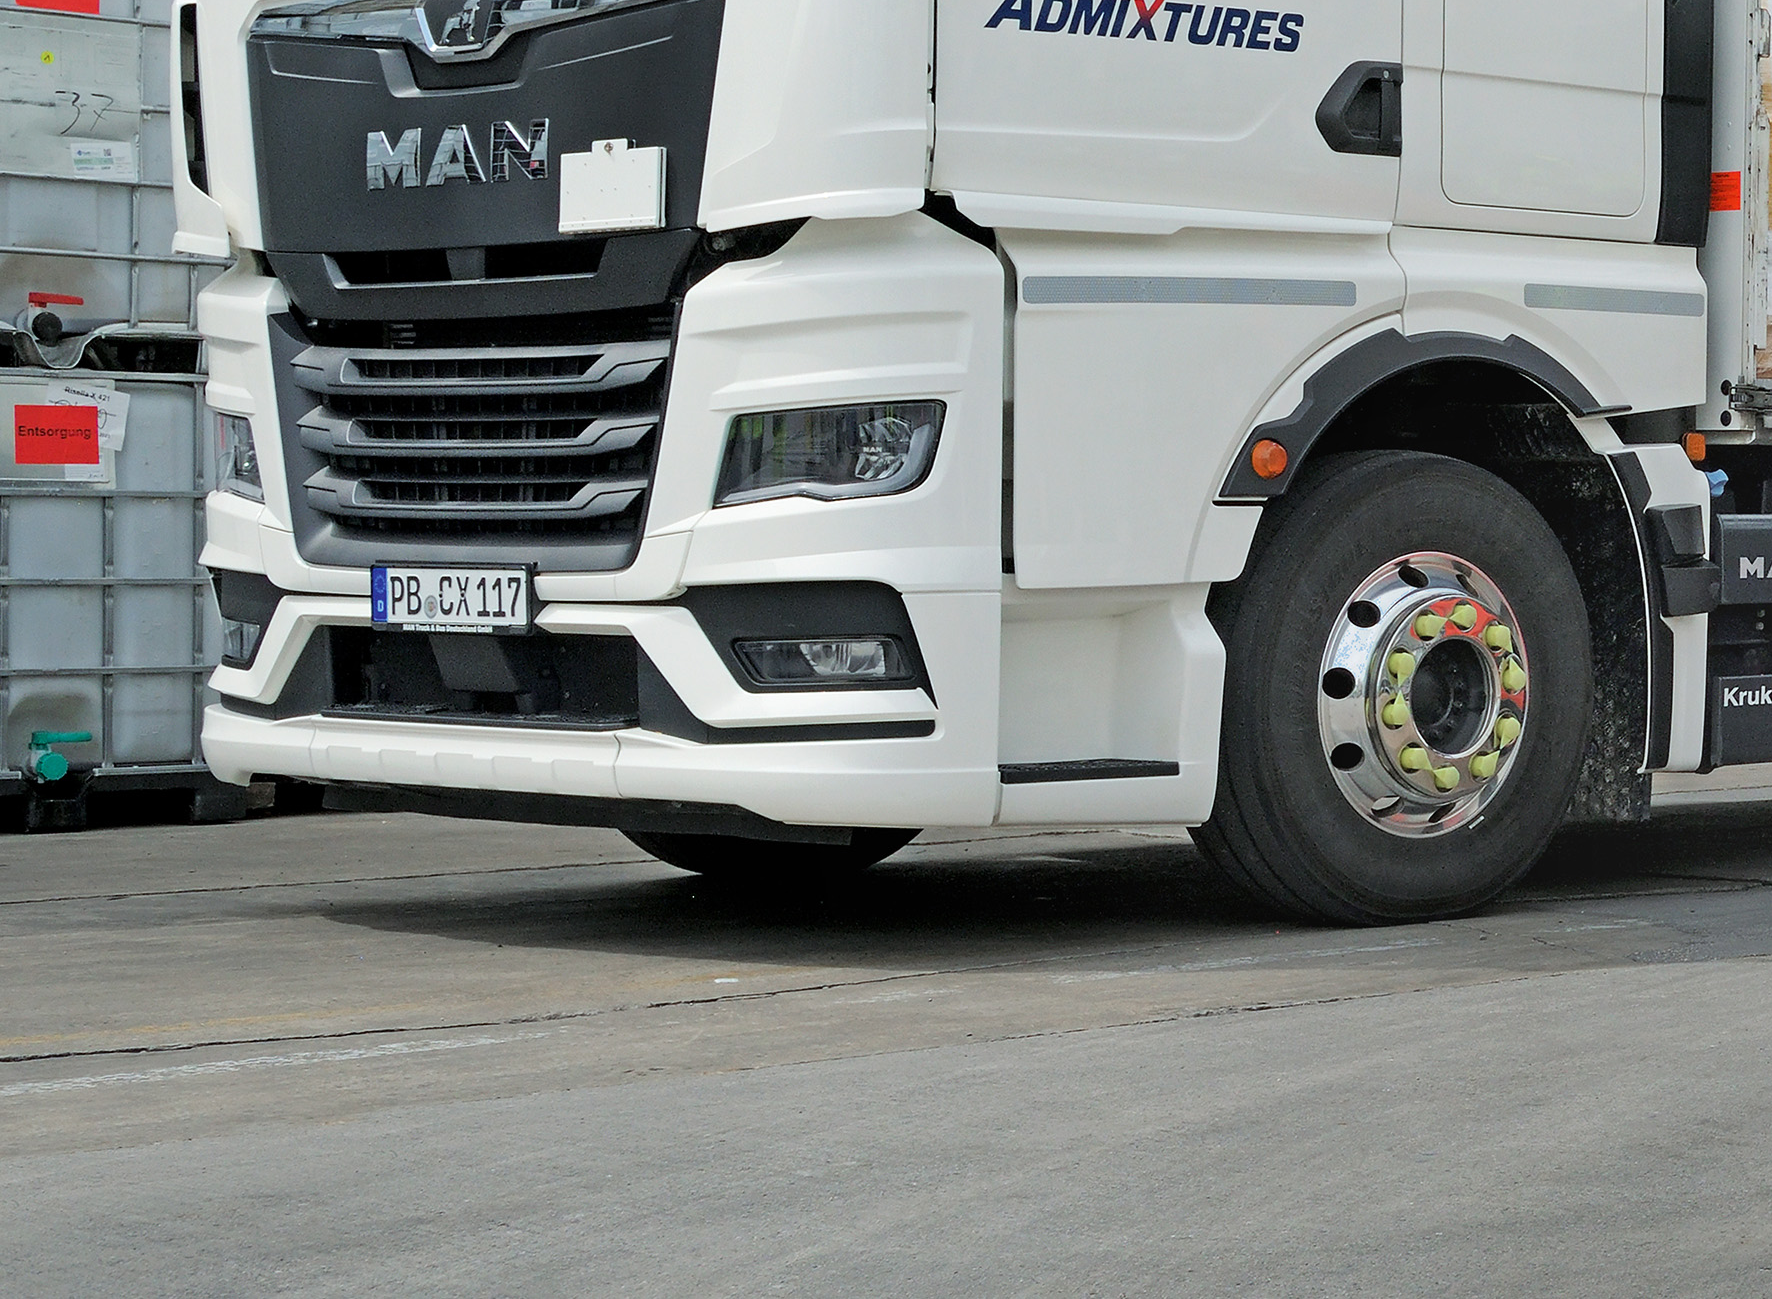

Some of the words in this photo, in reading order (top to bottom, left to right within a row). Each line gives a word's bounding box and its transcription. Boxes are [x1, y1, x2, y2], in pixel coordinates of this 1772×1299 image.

[367, 118, 549, 191] MAN
[18, 426, 91, 440] Entsorgung
[390, 576, 421, 615] PB
[438, 576, 470, 616] CX
[476, 577, 521, 617] 117
